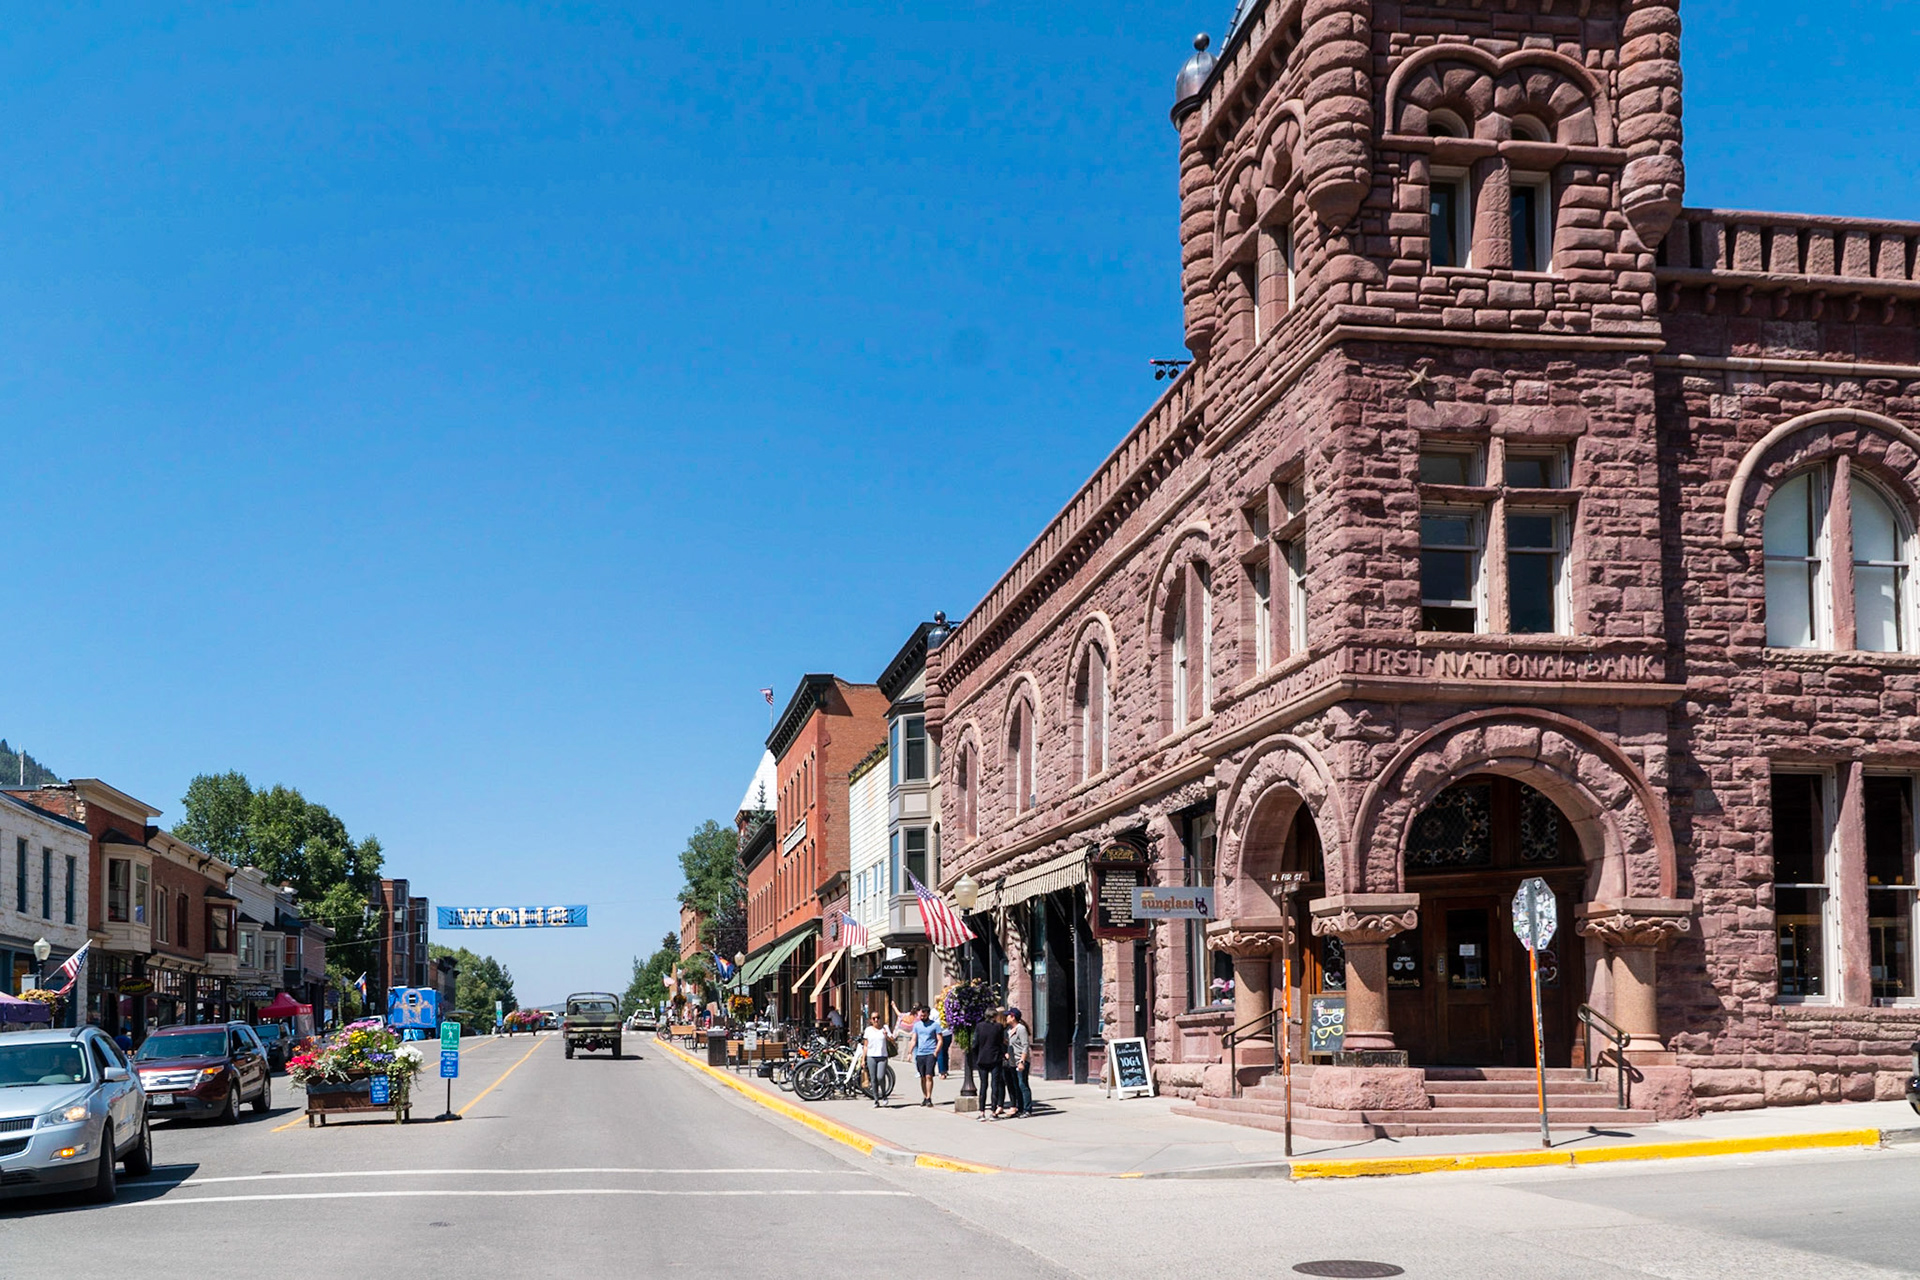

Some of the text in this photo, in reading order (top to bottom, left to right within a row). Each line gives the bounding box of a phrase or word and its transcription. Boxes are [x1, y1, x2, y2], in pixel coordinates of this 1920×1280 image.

[1349, 647, 1661, 681] FIRST NATIONAL BANK
[1245, 680, 1300, 720] NATIONAL
[1304, 651, 1340, 690] BANK
[1141, 895, 1194, 912] sunglass
[1120, 1056, 1141, 1067] YOGA
